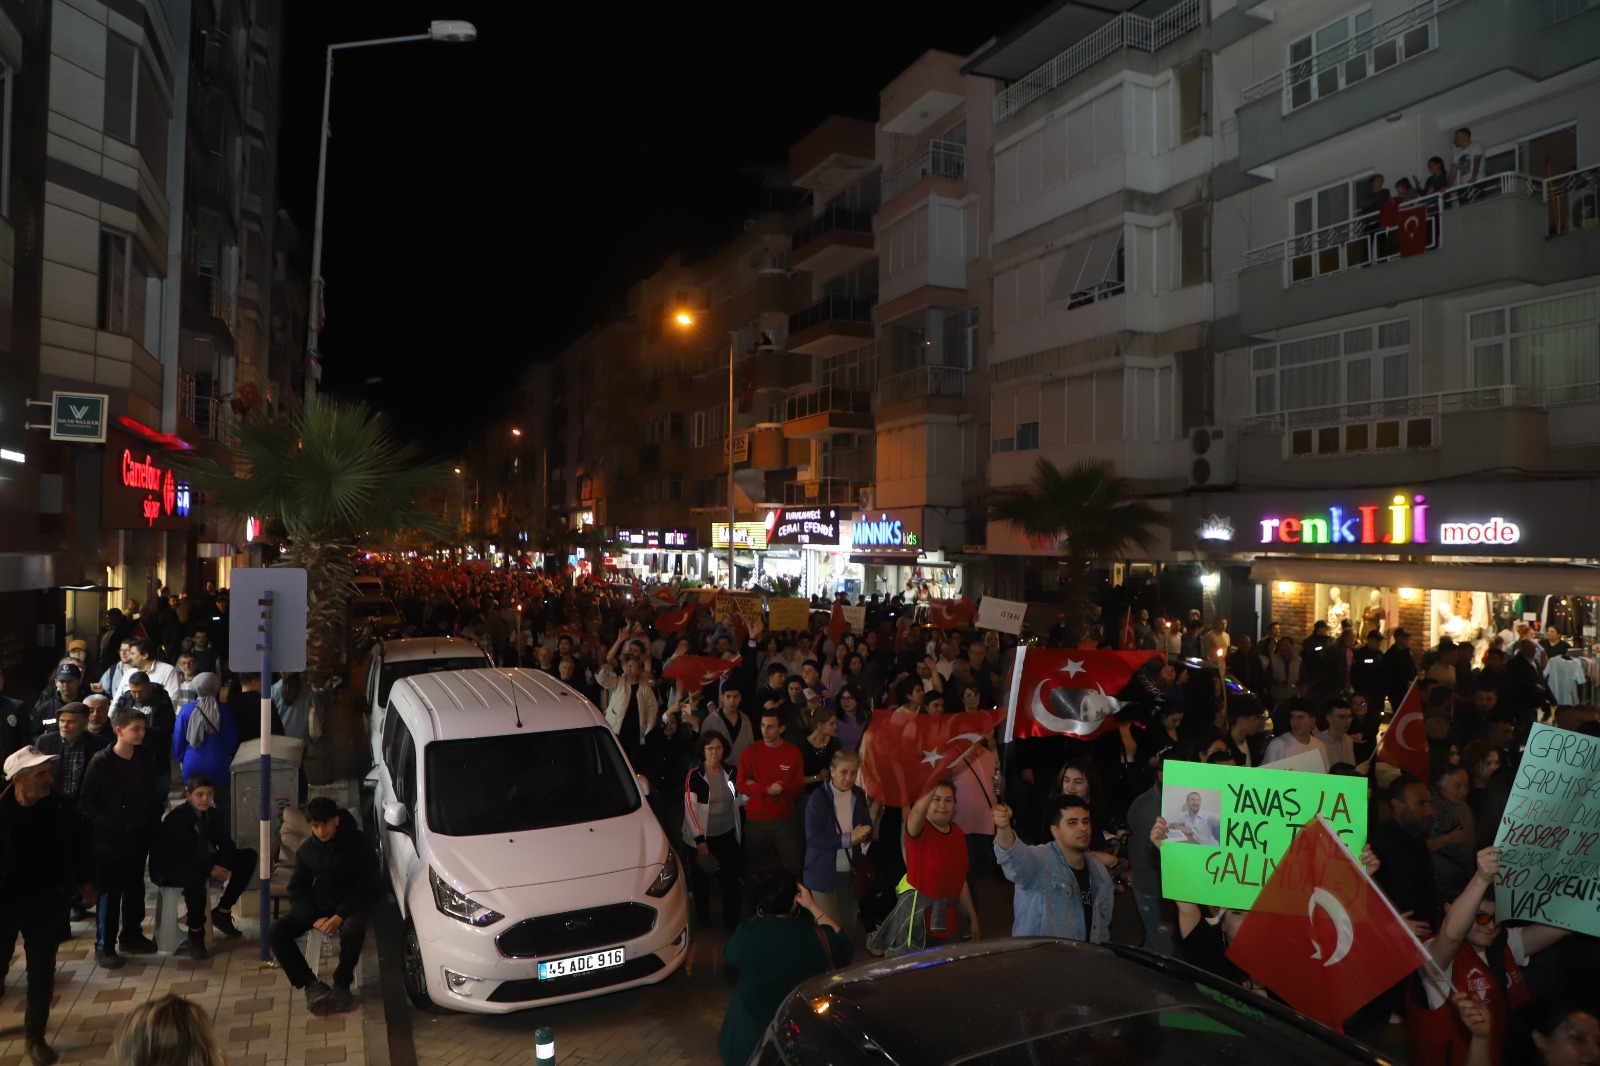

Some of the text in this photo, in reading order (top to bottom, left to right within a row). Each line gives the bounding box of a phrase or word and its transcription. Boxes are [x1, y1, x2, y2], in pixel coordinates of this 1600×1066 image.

[122, 448, 162, 491] Carrefour
[902, 532, 917, 546] kids
[1441, 519, 1517, 543] mode
[1227, 783, 1302, 821] YAVAŞ
[1226, 817, 1269, 855] KAÇ
[1499, 845, 1550, 871] ELİYOR
[549, 961, 565, 975] 45
[570, 957, 593, 973] ADC
[598, 950, 622, 967] 916
